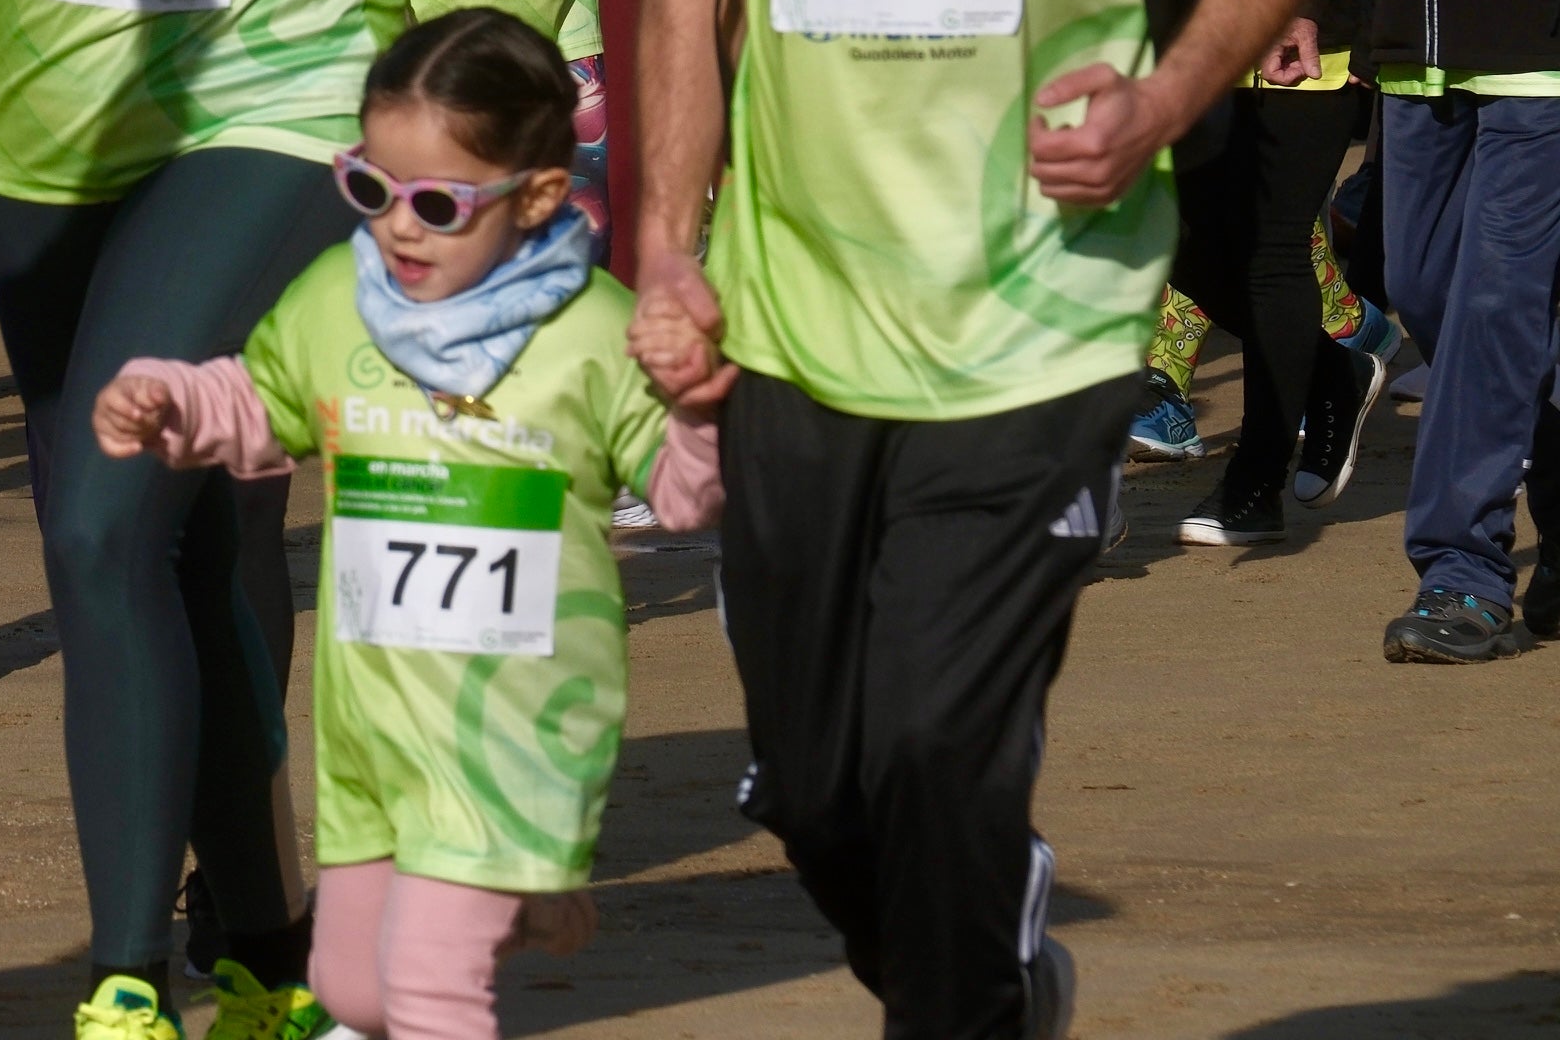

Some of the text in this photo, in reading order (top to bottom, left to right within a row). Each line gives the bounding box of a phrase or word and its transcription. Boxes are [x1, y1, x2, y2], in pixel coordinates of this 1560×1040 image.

[930, 45, 977, 59] Motor
[344, 396, 389, 433] En
[368, 460, 450, 479] en marcha
[387, 541, 518, 615] 771
